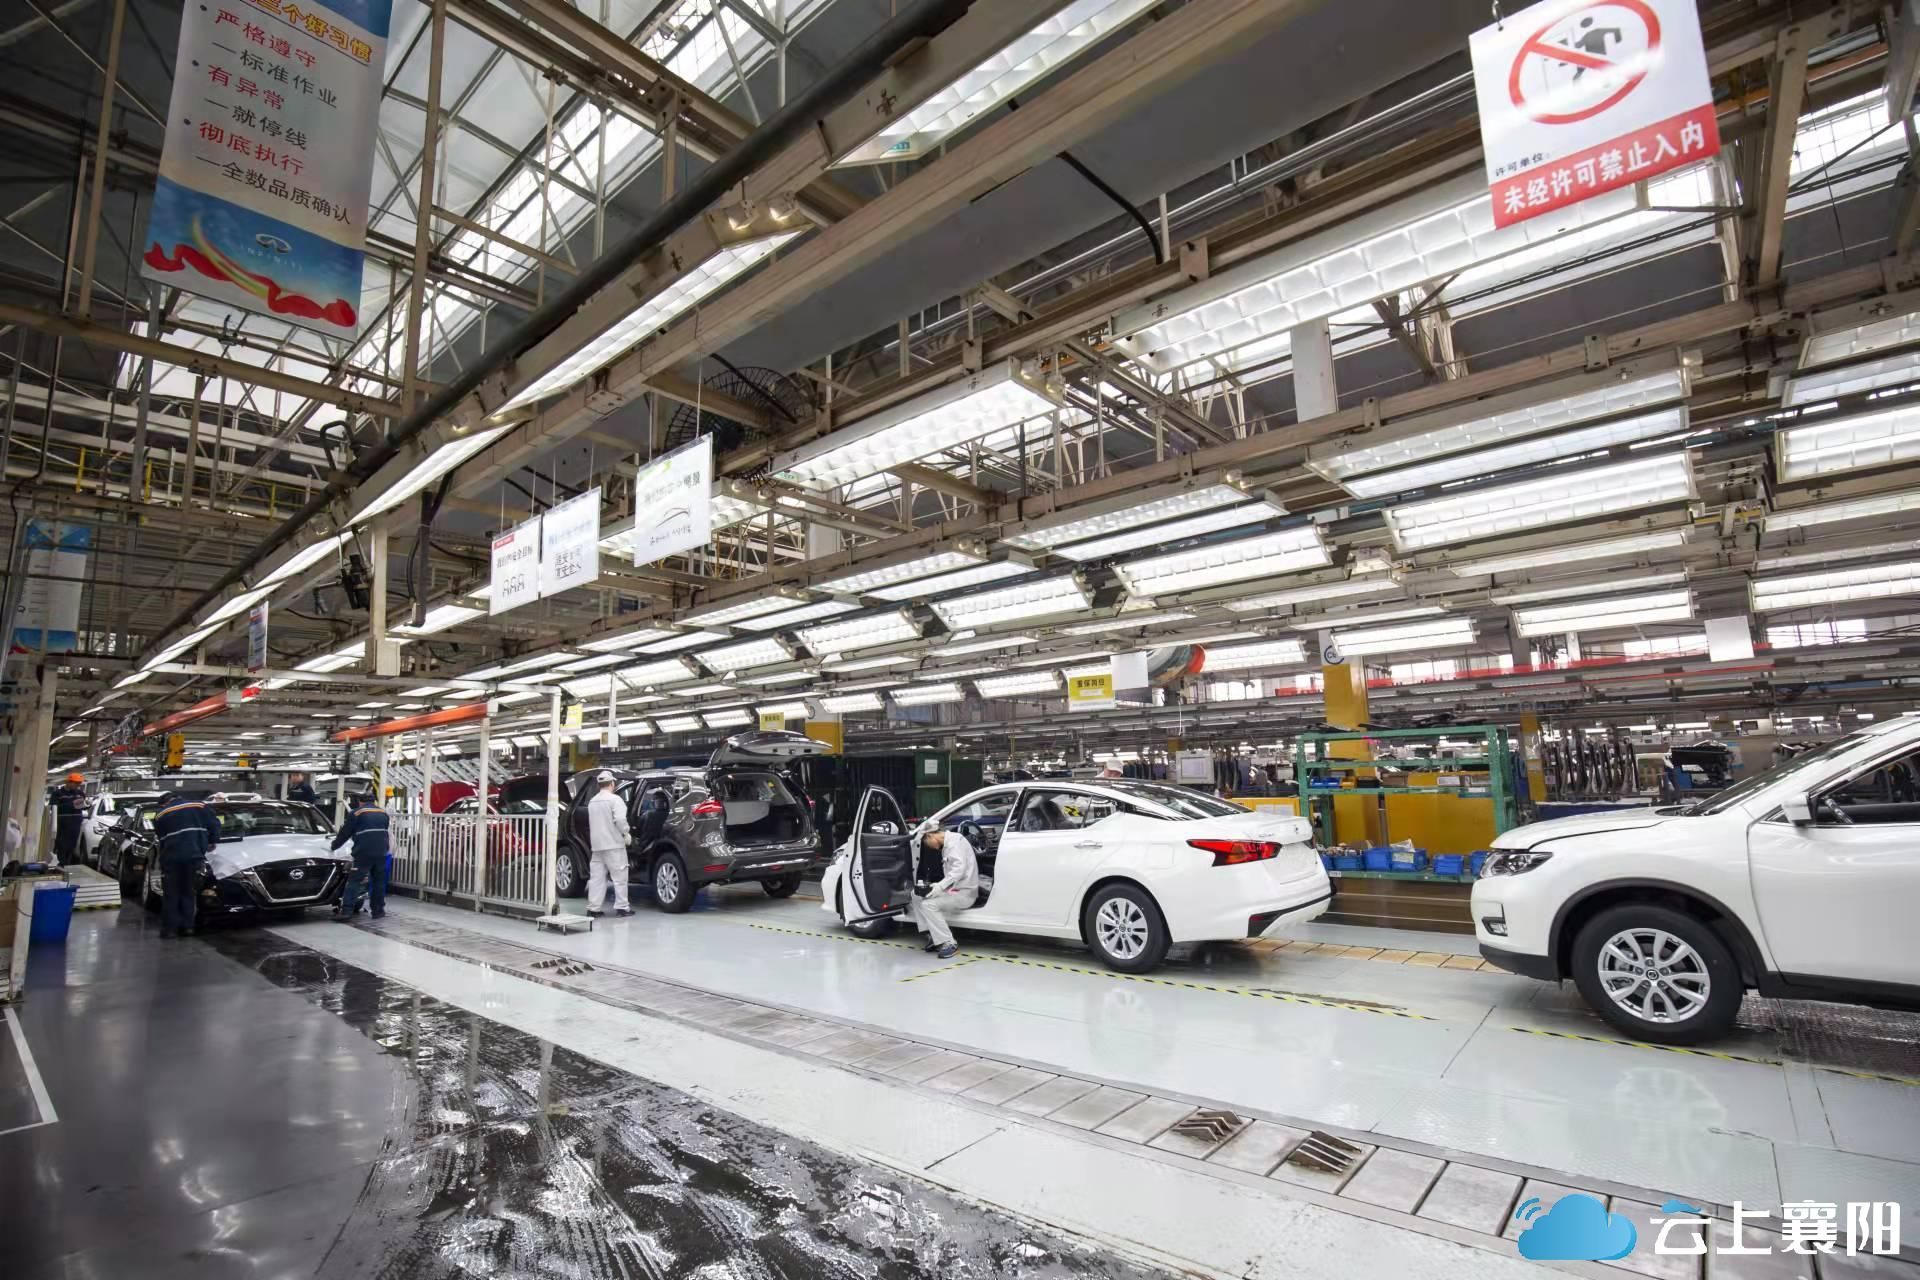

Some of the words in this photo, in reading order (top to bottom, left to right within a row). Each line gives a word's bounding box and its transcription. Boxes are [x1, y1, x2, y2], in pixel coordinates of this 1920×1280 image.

[214, 8, 317, 69] 严格遵守
[208, 64, 285, 110] 有异常
[199, 121, 305, 177] 彻底执行
[1504, 120, 1705, 216] 未经许可禁止入内
